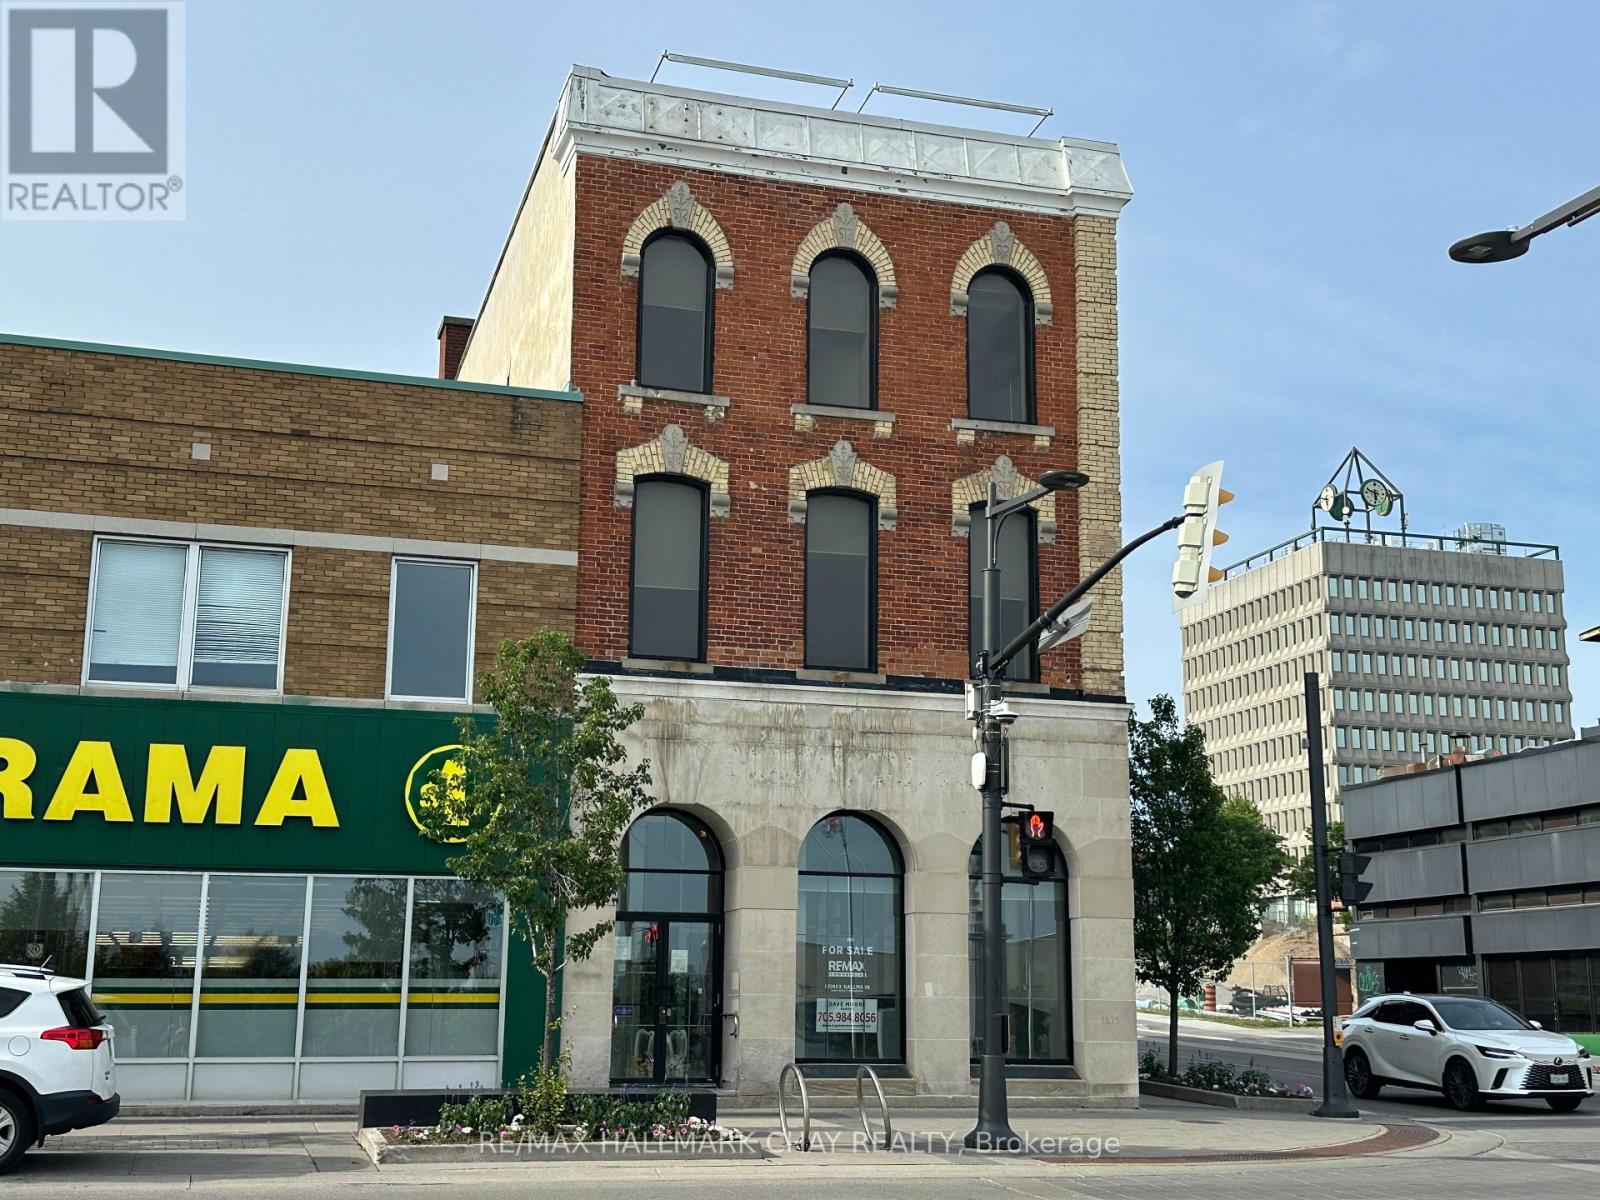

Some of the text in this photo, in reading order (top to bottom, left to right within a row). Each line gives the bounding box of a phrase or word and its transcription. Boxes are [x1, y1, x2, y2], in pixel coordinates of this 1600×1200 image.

[0, 737, 340, 828] RAMA
[822, 945, 874, 956] FOR SALE
